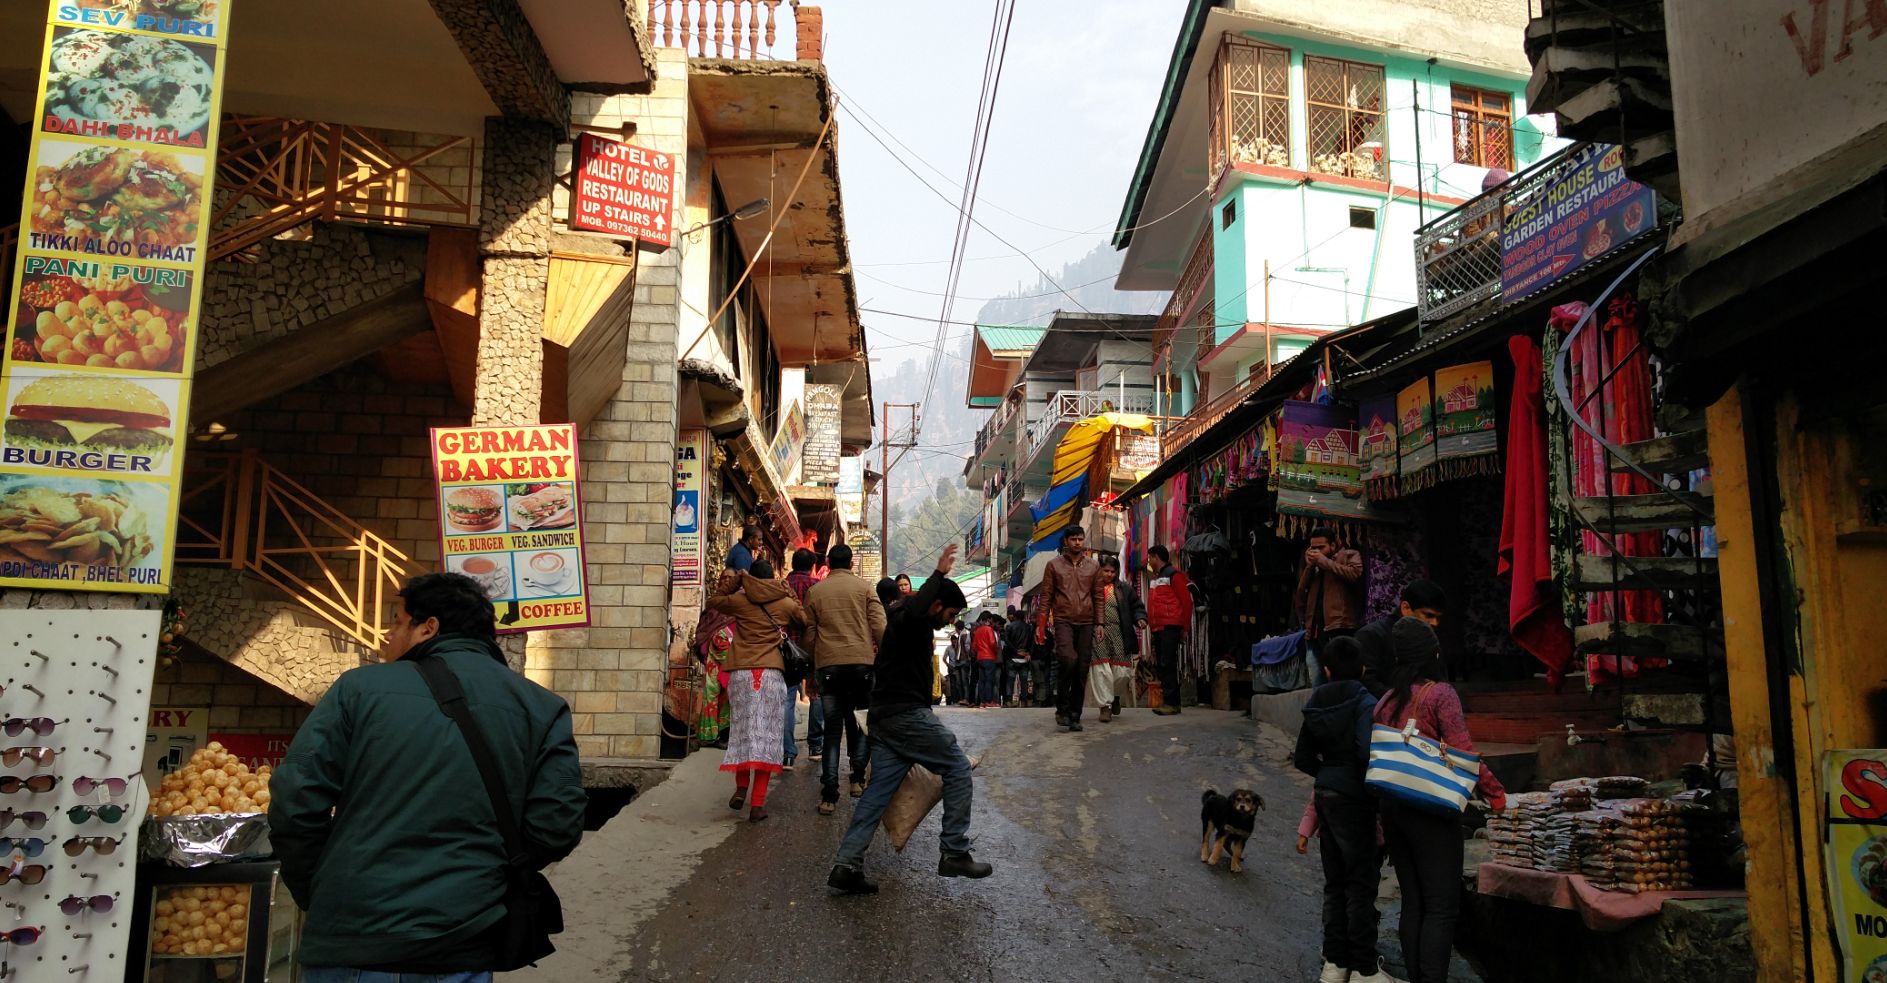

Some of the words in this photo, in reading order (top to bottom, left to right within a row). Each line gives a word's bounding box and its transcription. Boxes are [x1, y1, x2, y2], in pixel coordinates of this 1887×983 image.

[58, 5, 125, 27] SEV
[135, 14, 217, 38] PURI
[44, 115, 111, 138] DAHI
[116, 123, 205, 149] BHALA
[591, 138, 651, 167] HOTEL
[586, 156, 624, 183] VALLEY
[626, 166, 640, 186] OF
[641, 170, 670, 194] GODS
[1547, 163, 1595, 209] HOUSE
[582, 179, 669, 214] RESTAURANT
[1504, 211, 1553, 250] GARDEN
[1557, 166, 1627, 219] RESTAURA
[581, 214, 605, 228] MOB.
[607, 220, 639, 235] 097362
[582, 200, 601, 214] UP
[604, 205, 651, 226] STAIRS
[1503, 234, 1546, 268] WOOD
[1549, 208, 1590, 240] OVEN
[1594, 180, 1642, 216] PIZZA
[30, 232, 79, 252] TIKKI
[84, 237, 132, 257] ALOO
[138, 242, 196, 263] CHAAT
[25, 256, 100, 279] PANI
[111, 264, 187, 288] PURI
[438, 429, 570, 455] GERMAN
[2, 446, 153, 472] BURGER
[440, 455, 572, 482] BAKERY
[447, 539, 468, 552] VEG.
[469, 536, 504, 551] BURGER
[511, 535, 531, 549] VEG.
[532, 532, 575, 548] SANDWICH
[31, 562, 80, 580] CHAAT
[128, 567, 162, 584] PURI
[521, 601, 583, 619] COFFEE
[148, 710, 193, 728] RY
